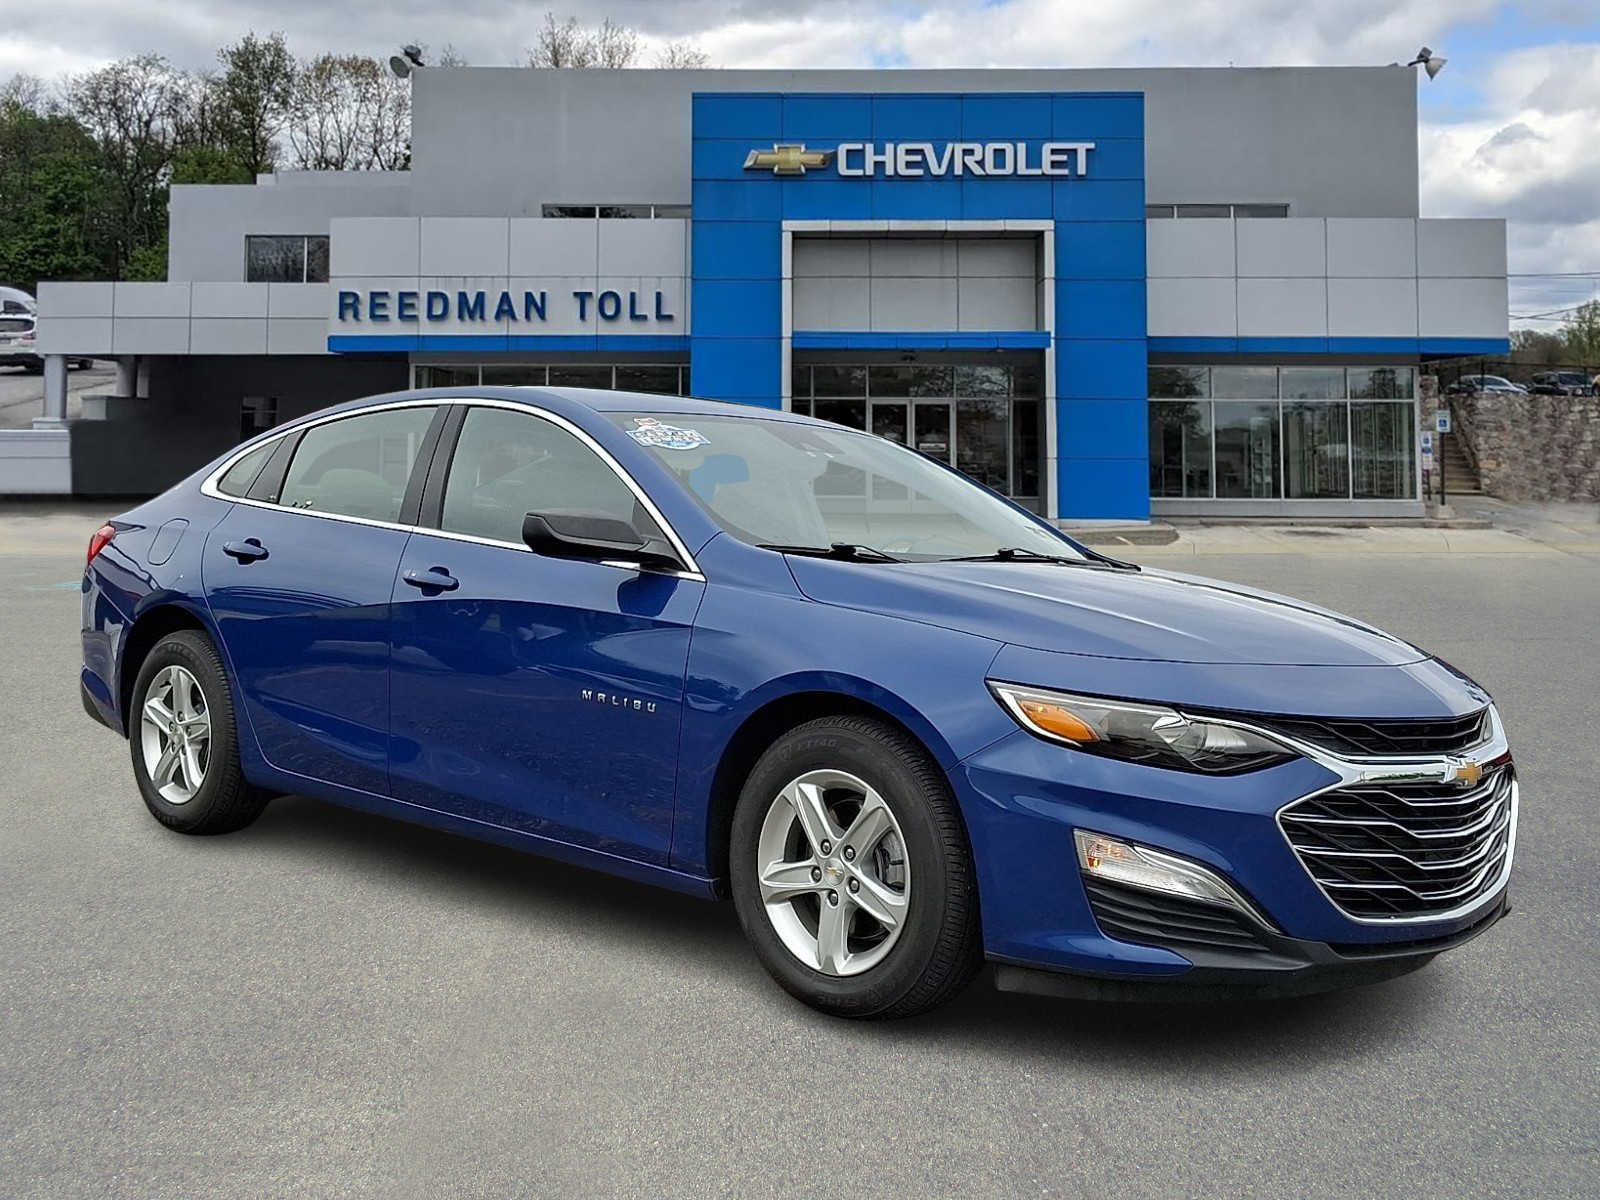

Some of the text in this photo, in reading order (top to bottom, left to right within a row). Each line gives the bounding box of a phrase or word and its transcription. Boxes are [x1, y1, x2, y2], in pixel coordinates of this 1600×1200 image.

[837, 142, 1096, 177] CHEVROLET
[338, 291, 674, 322] REEDMAN TOLL
[581, 689, 656, 713] MALIBU
